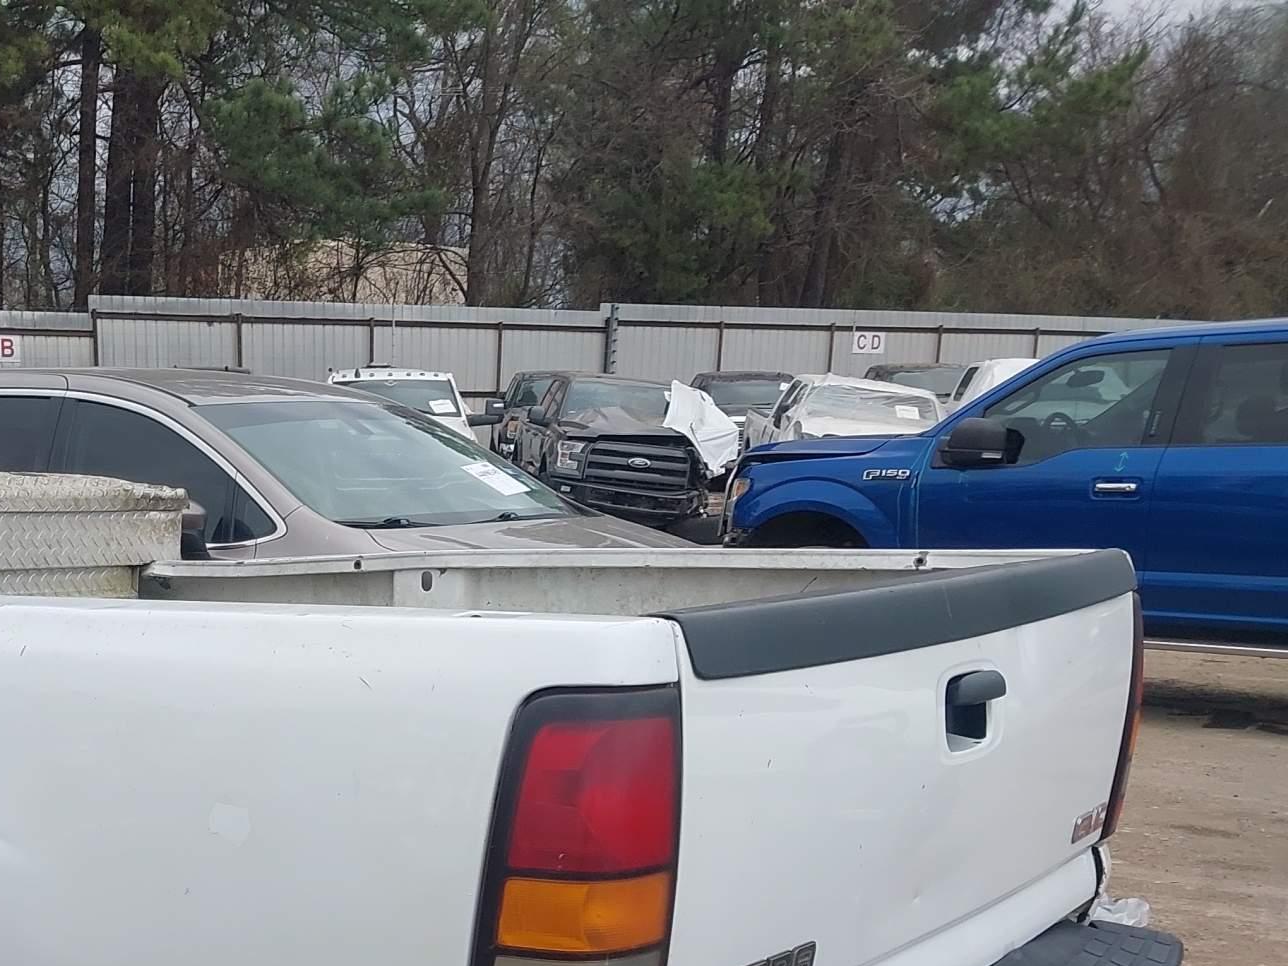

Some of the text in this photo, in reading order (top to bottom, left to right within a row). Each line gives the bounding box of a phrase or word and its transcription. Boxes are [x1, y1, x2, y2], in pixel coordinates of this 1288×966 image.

[0, 338, 15, 358] B
[857, 334, 881, 350] C D
